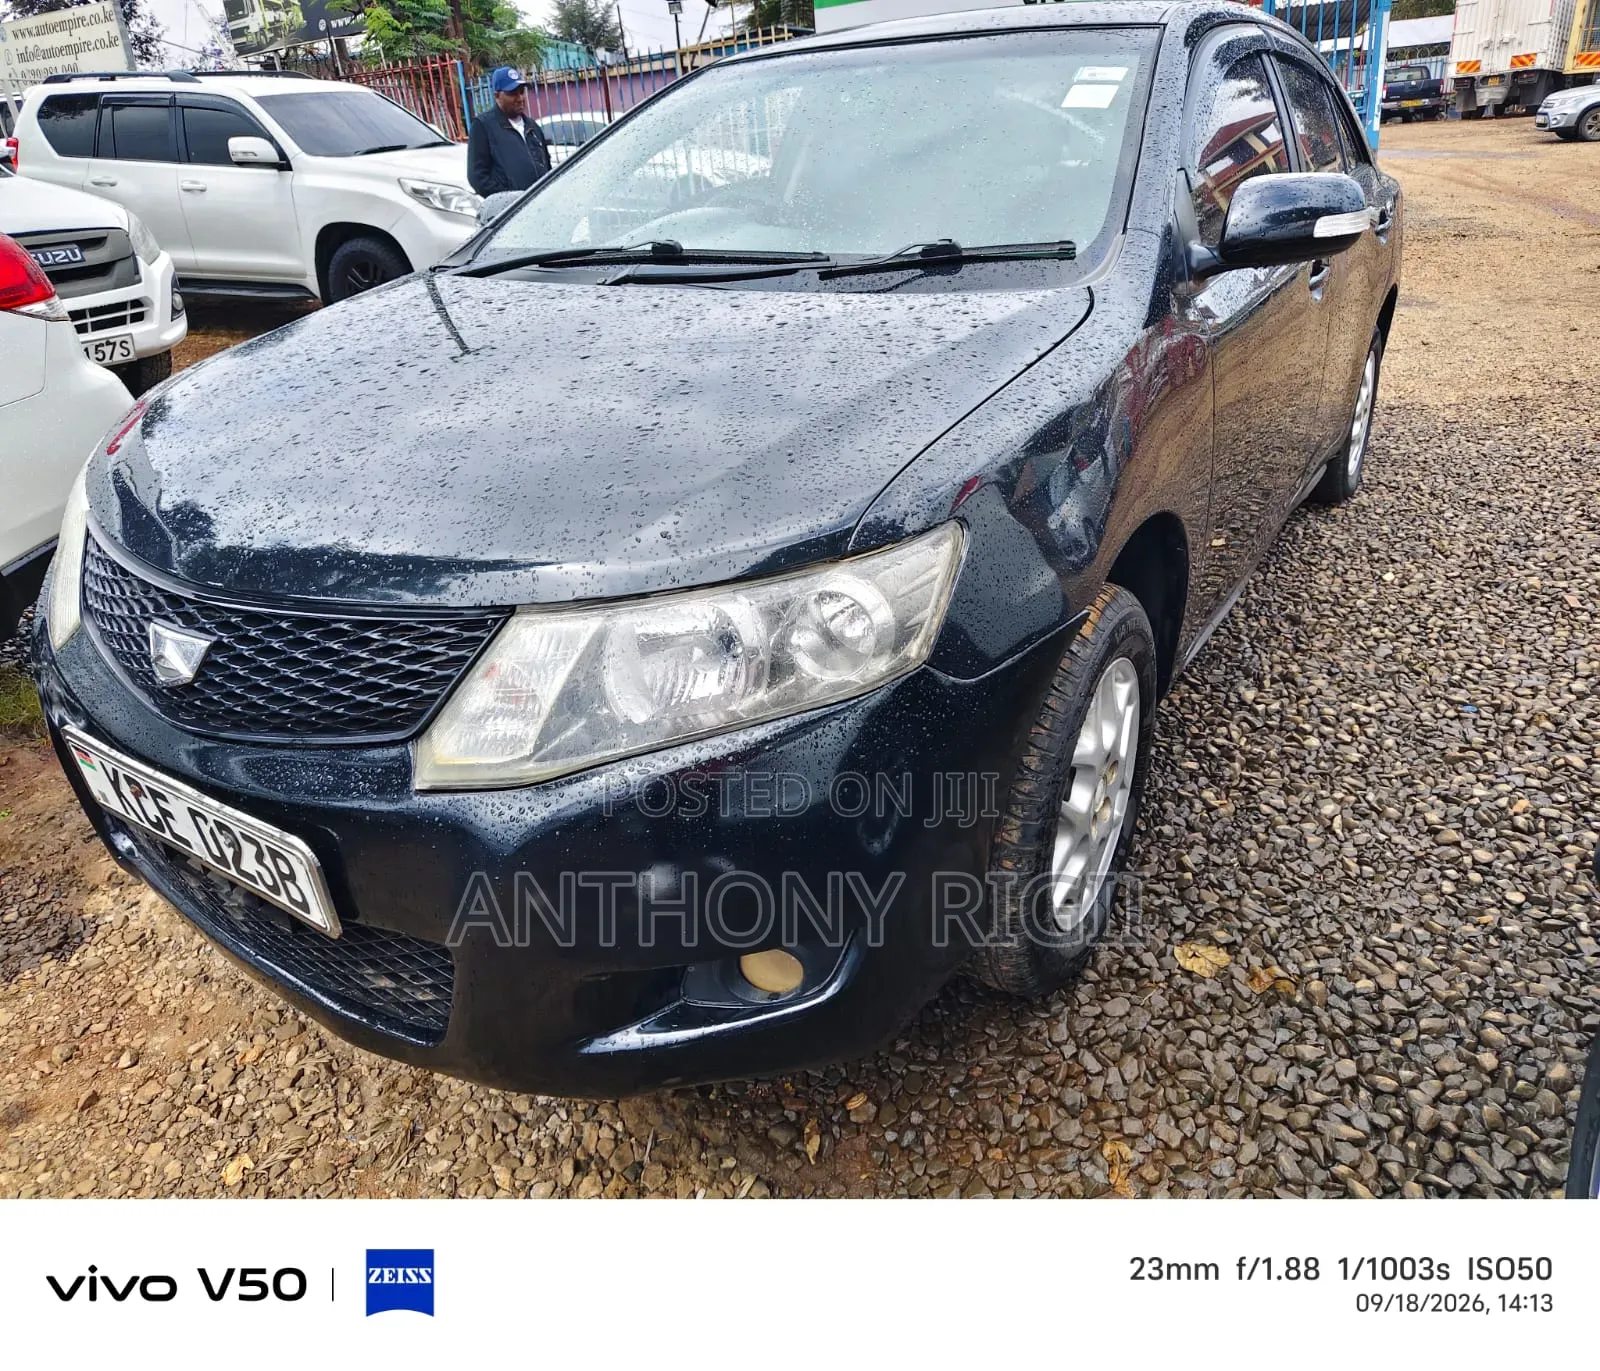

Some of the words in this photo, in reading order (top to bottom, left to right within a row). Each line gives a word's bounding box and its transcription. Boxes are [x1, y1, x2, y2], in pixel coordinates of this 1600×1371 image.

[12, 5, 114, 41] www.autoempire.co.ke
[16, 30, 119, 64] info@autoempire.co.ke
[31, 247, 82, 265] UZU
[99, 760, 193, 850] KCE
[187, 807, 311, 915] 023B
